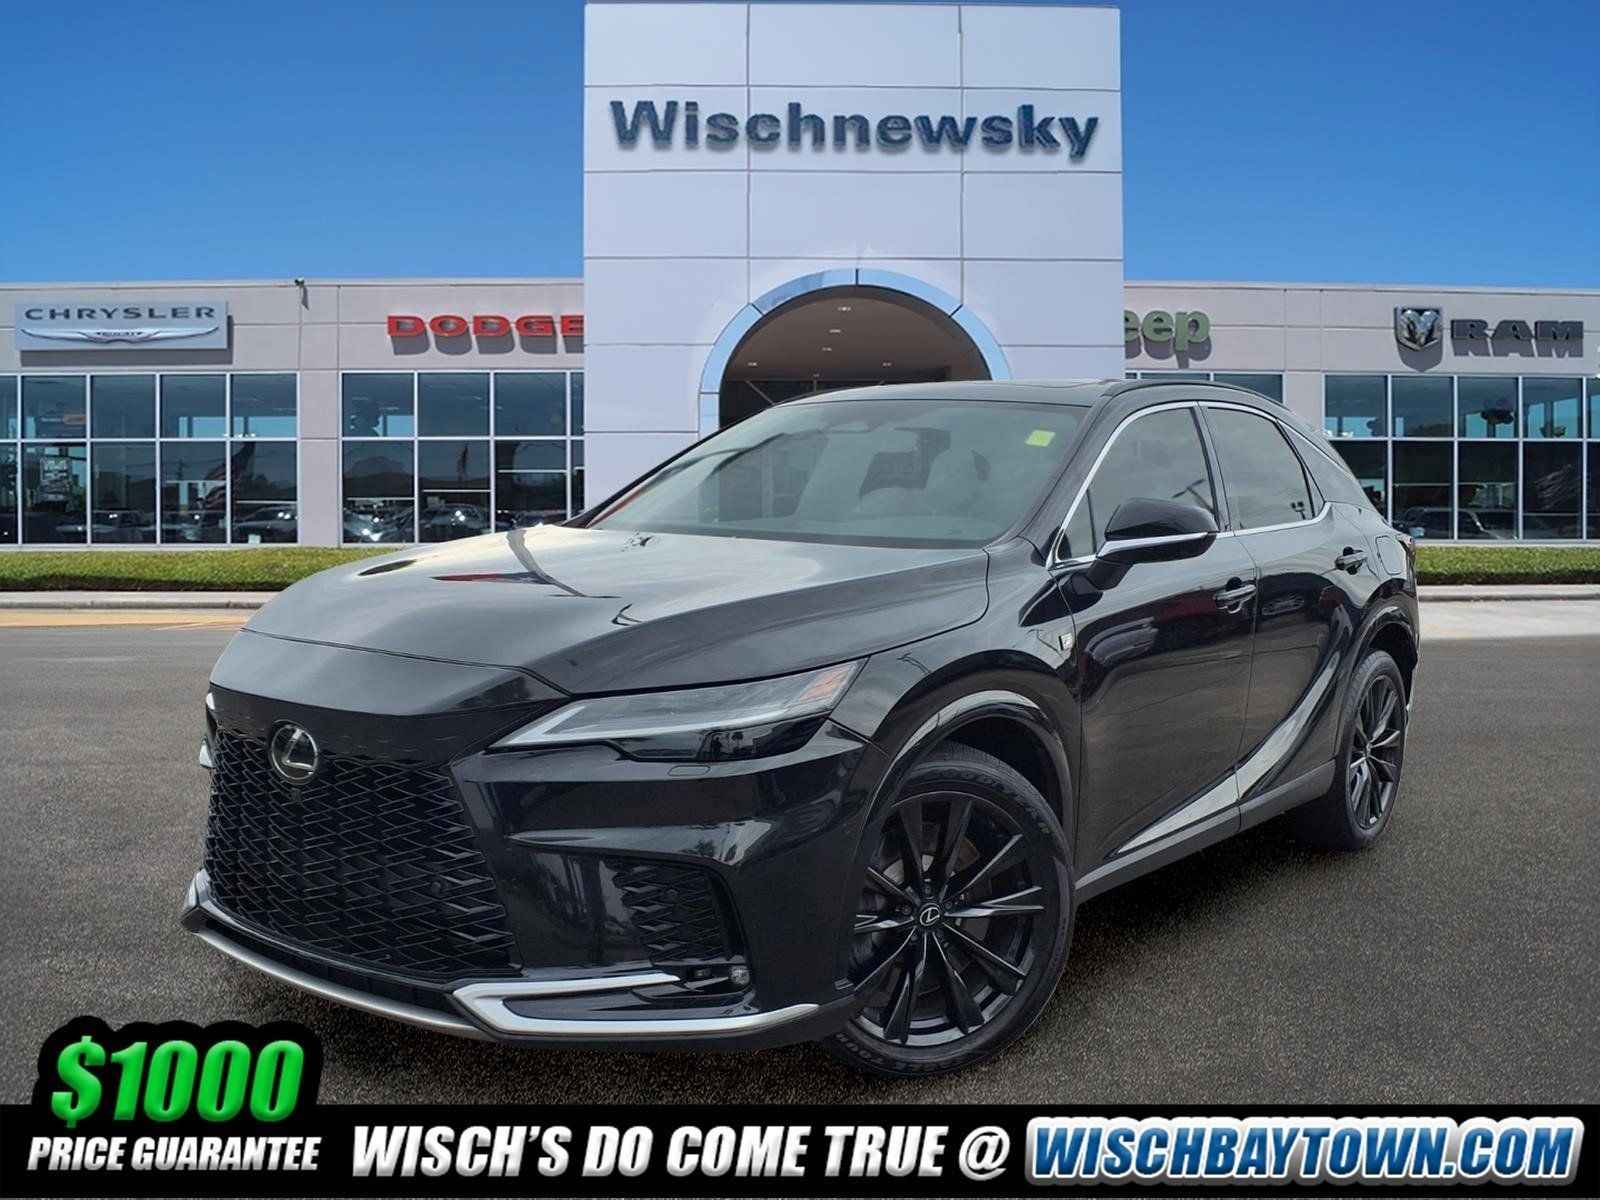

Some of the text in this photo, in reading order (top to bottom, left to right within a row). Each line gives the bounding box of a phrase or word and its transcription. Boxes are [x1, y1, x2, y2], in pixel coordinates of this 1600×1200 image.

[610, 100, 1099, 159] Wischnewsky
[25, 306, 216, 321] CHRYSLER
[387, 315, 584, 336] DODGE
[1451, 319, 1584, 340] RAM
